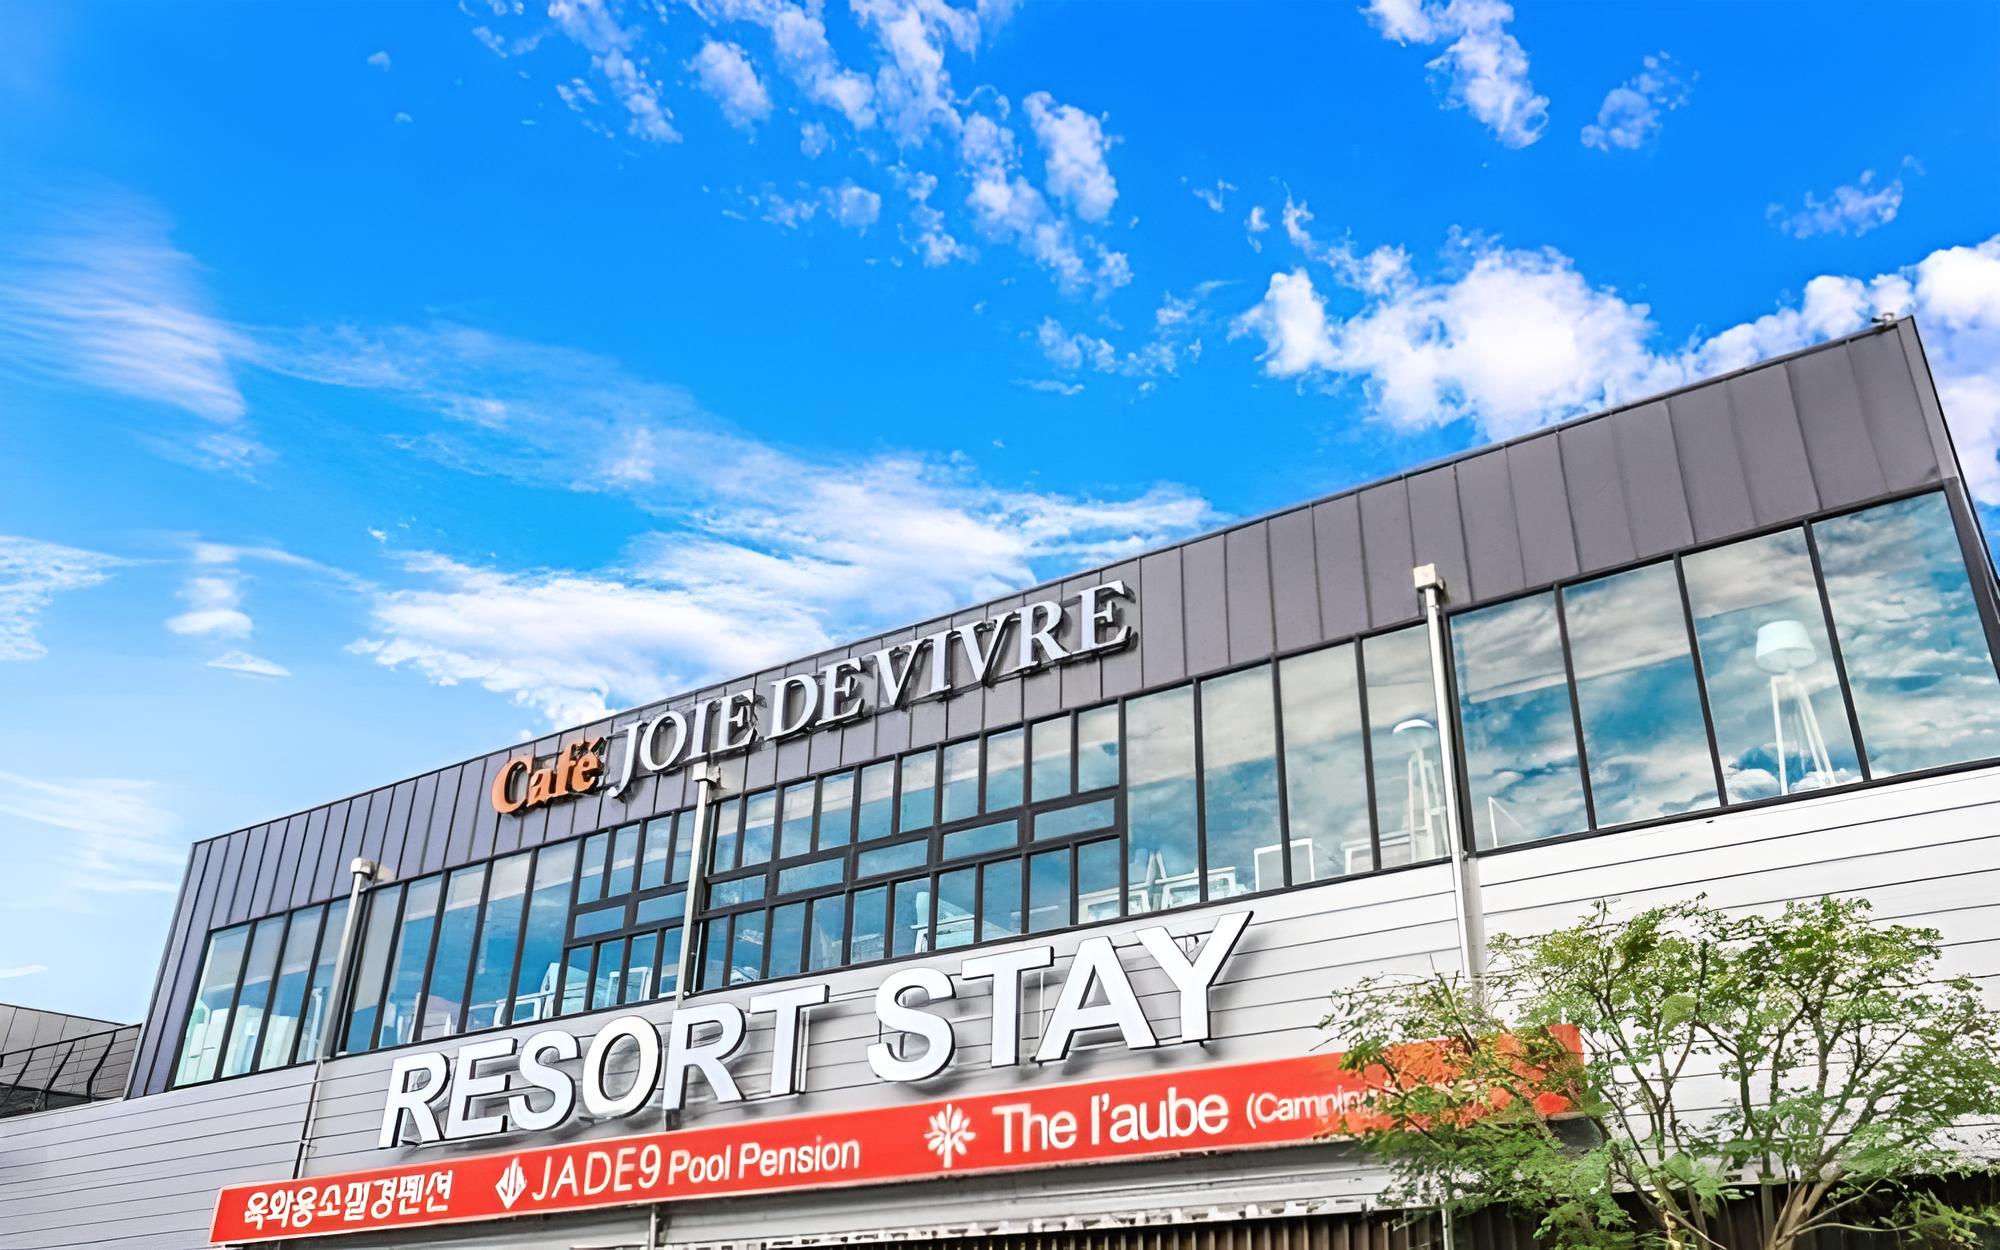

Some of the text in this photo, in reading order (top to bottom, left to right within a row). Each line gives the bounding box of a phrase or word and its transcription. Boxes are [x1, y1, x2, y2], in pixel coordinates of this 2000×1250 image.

[607, 688, 757, 799] JOIE
[378, 911, 1254, 1149] RESORT STAY
[532, 1135, 860, 1201] JADE9 Pool Pension
[992, 1103, 1077, 1153] The
